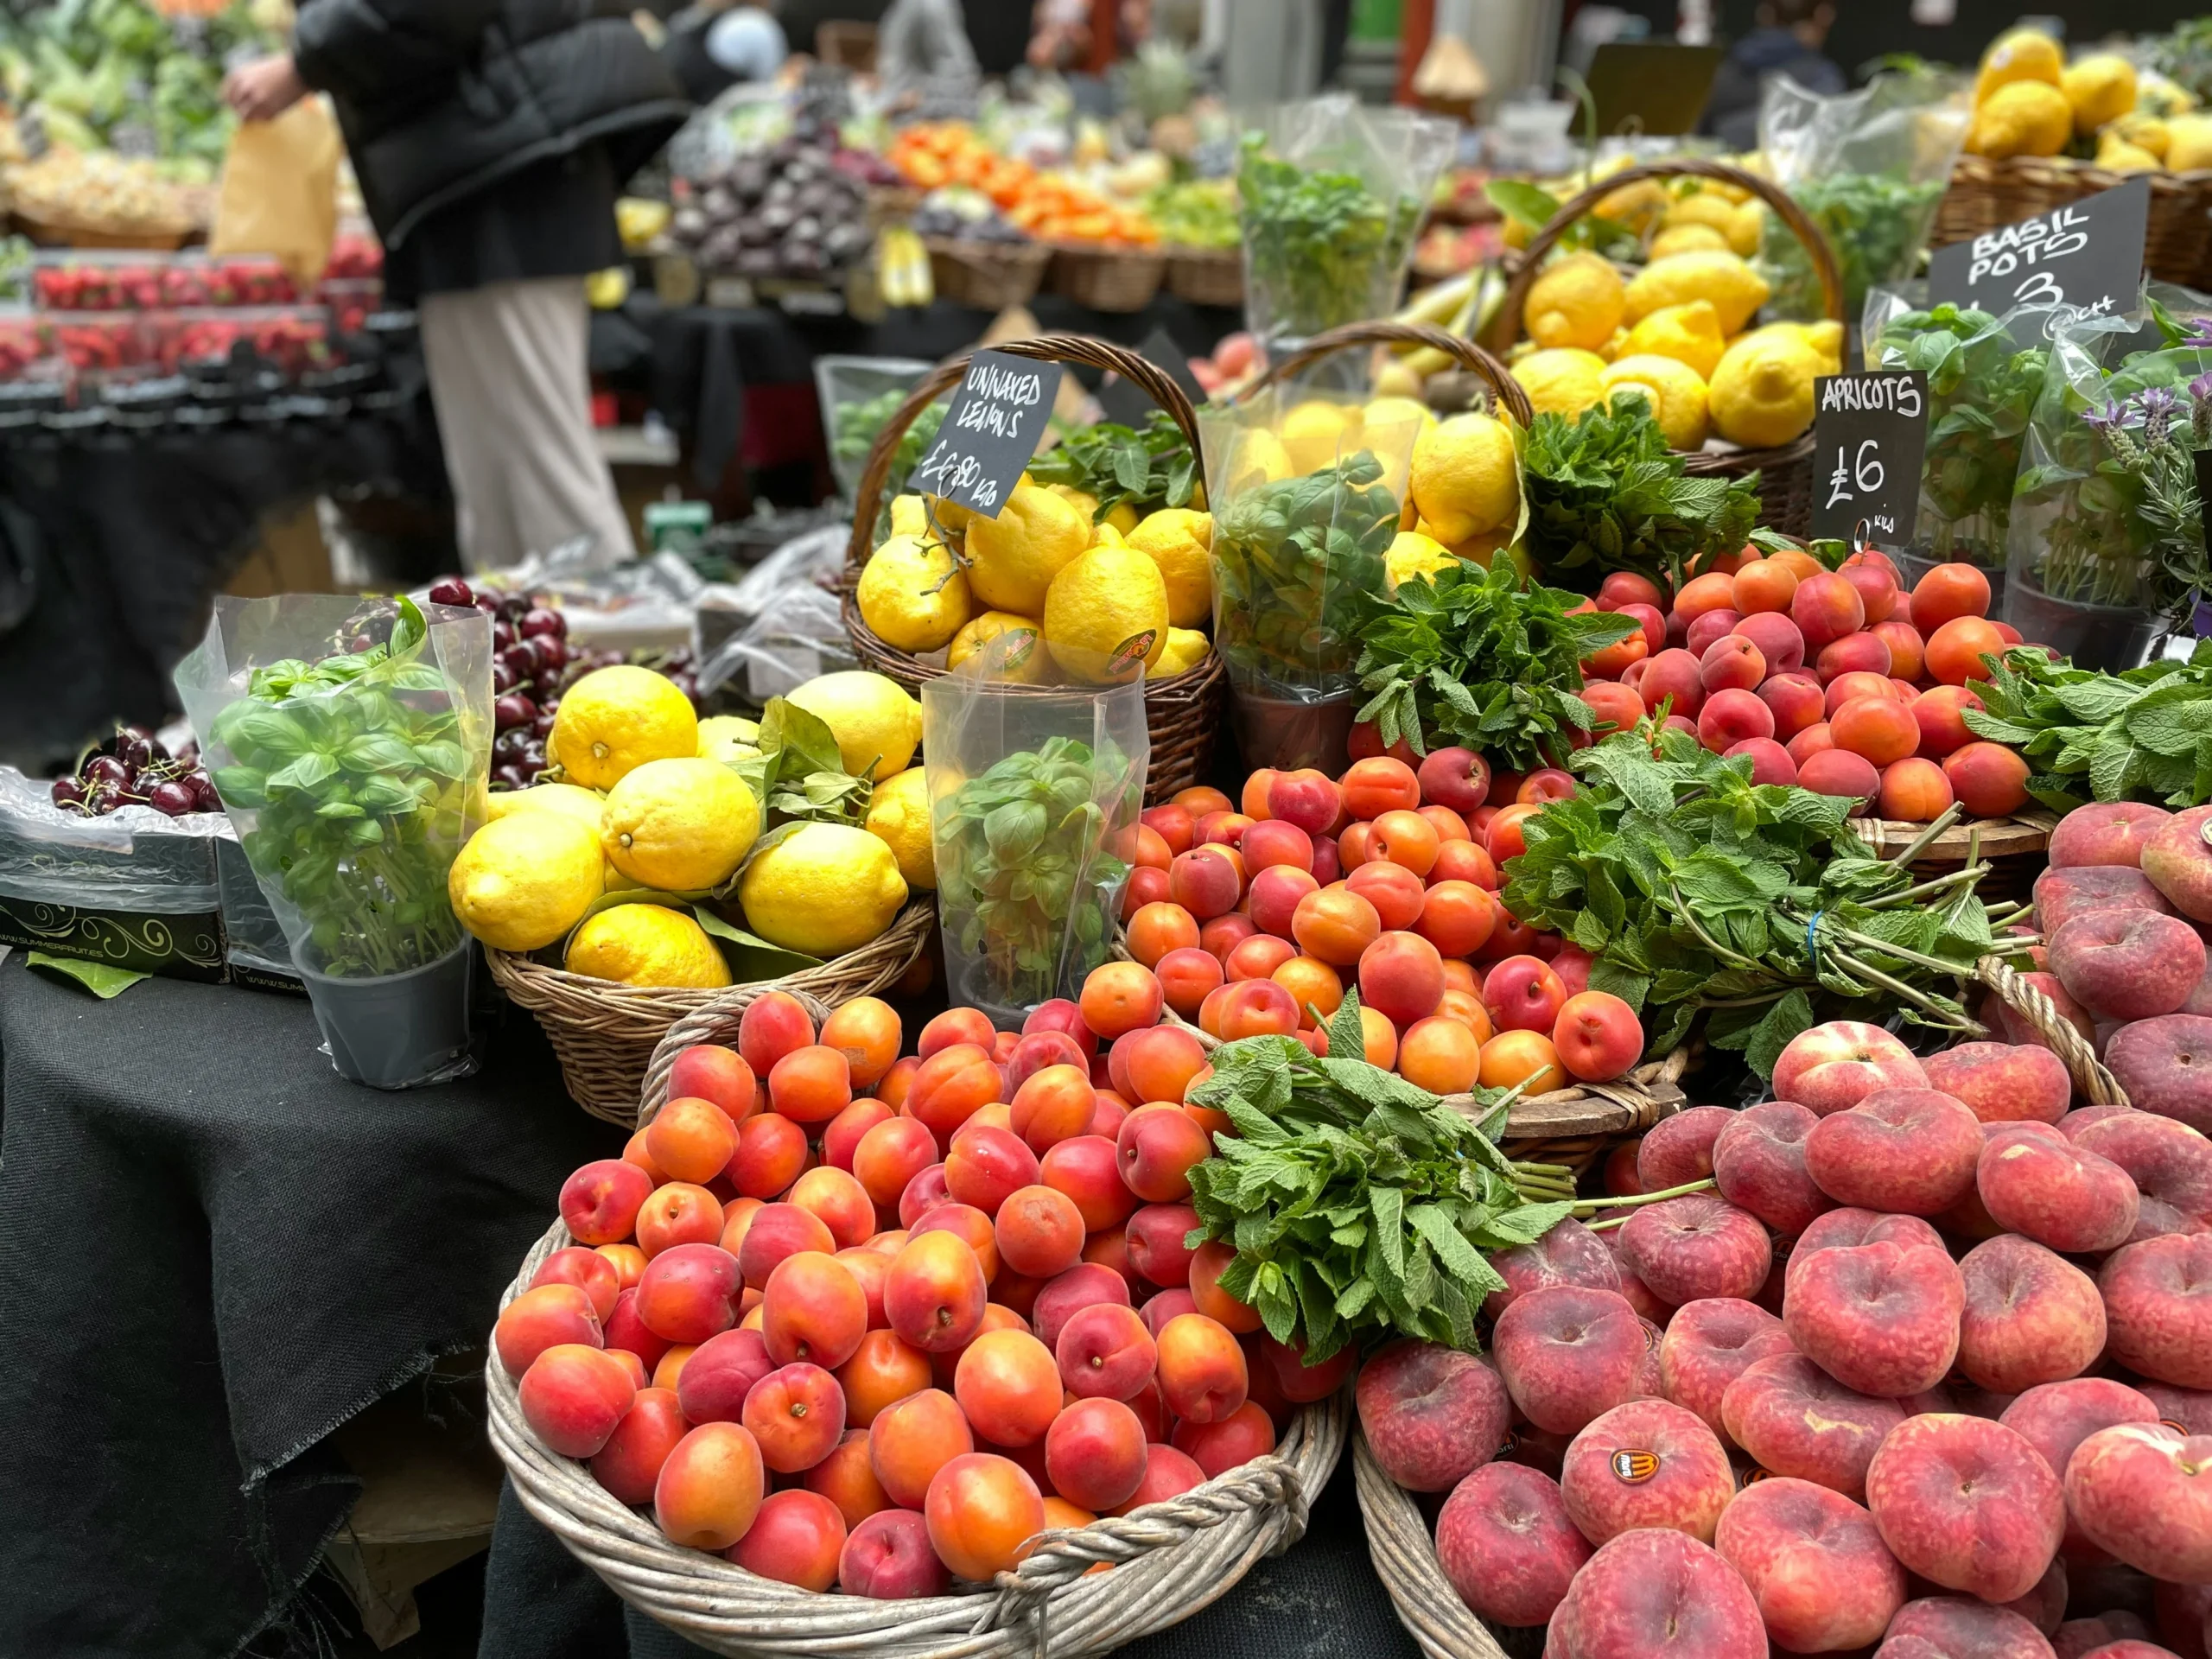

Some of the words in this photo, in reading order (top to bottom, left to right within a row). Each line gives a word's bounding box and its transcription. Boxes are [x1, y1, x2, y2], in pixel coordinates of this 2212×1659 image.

[1972, 207, 2090, 260] BASIL
[1967, 232, 2088, 286] POTS
[967, 363, 1041, 406] UNWAXED
[1821, 376, 1922, 417] APRICOTS
[956, 399, 1023, 438] LEMONS
[1825, 439, 1885, 510] £6
